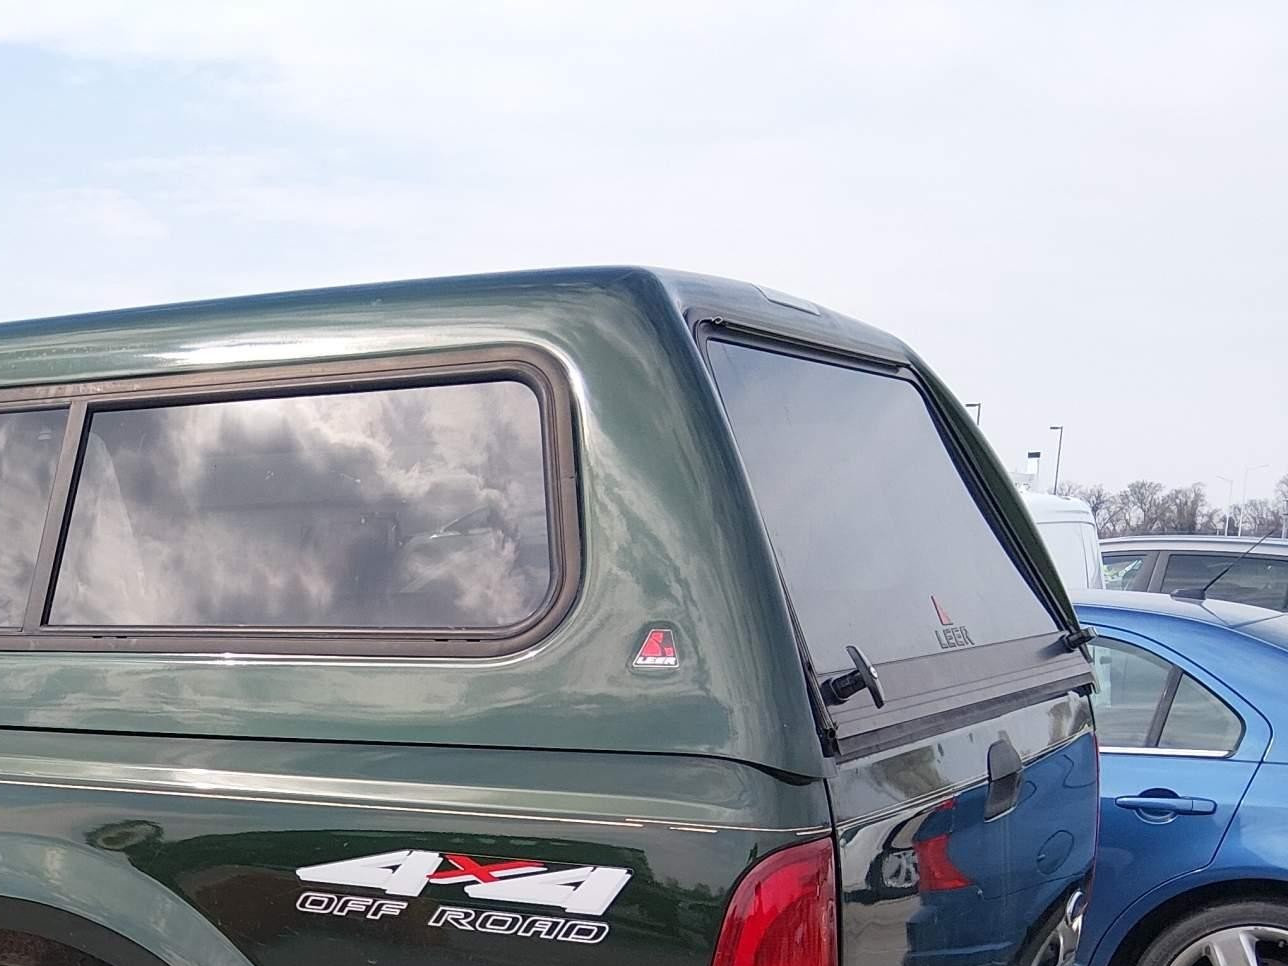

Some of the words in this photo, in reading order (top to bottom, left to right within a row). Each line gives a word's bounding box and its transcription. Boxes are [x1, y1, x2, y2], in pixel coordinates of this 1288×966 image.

[934, 625, 976, 650] LEER
[636, 655, 677, 666] LEER
[294, 891, 410, 921] OFF
[427, 905, 610, 945] ROAD
